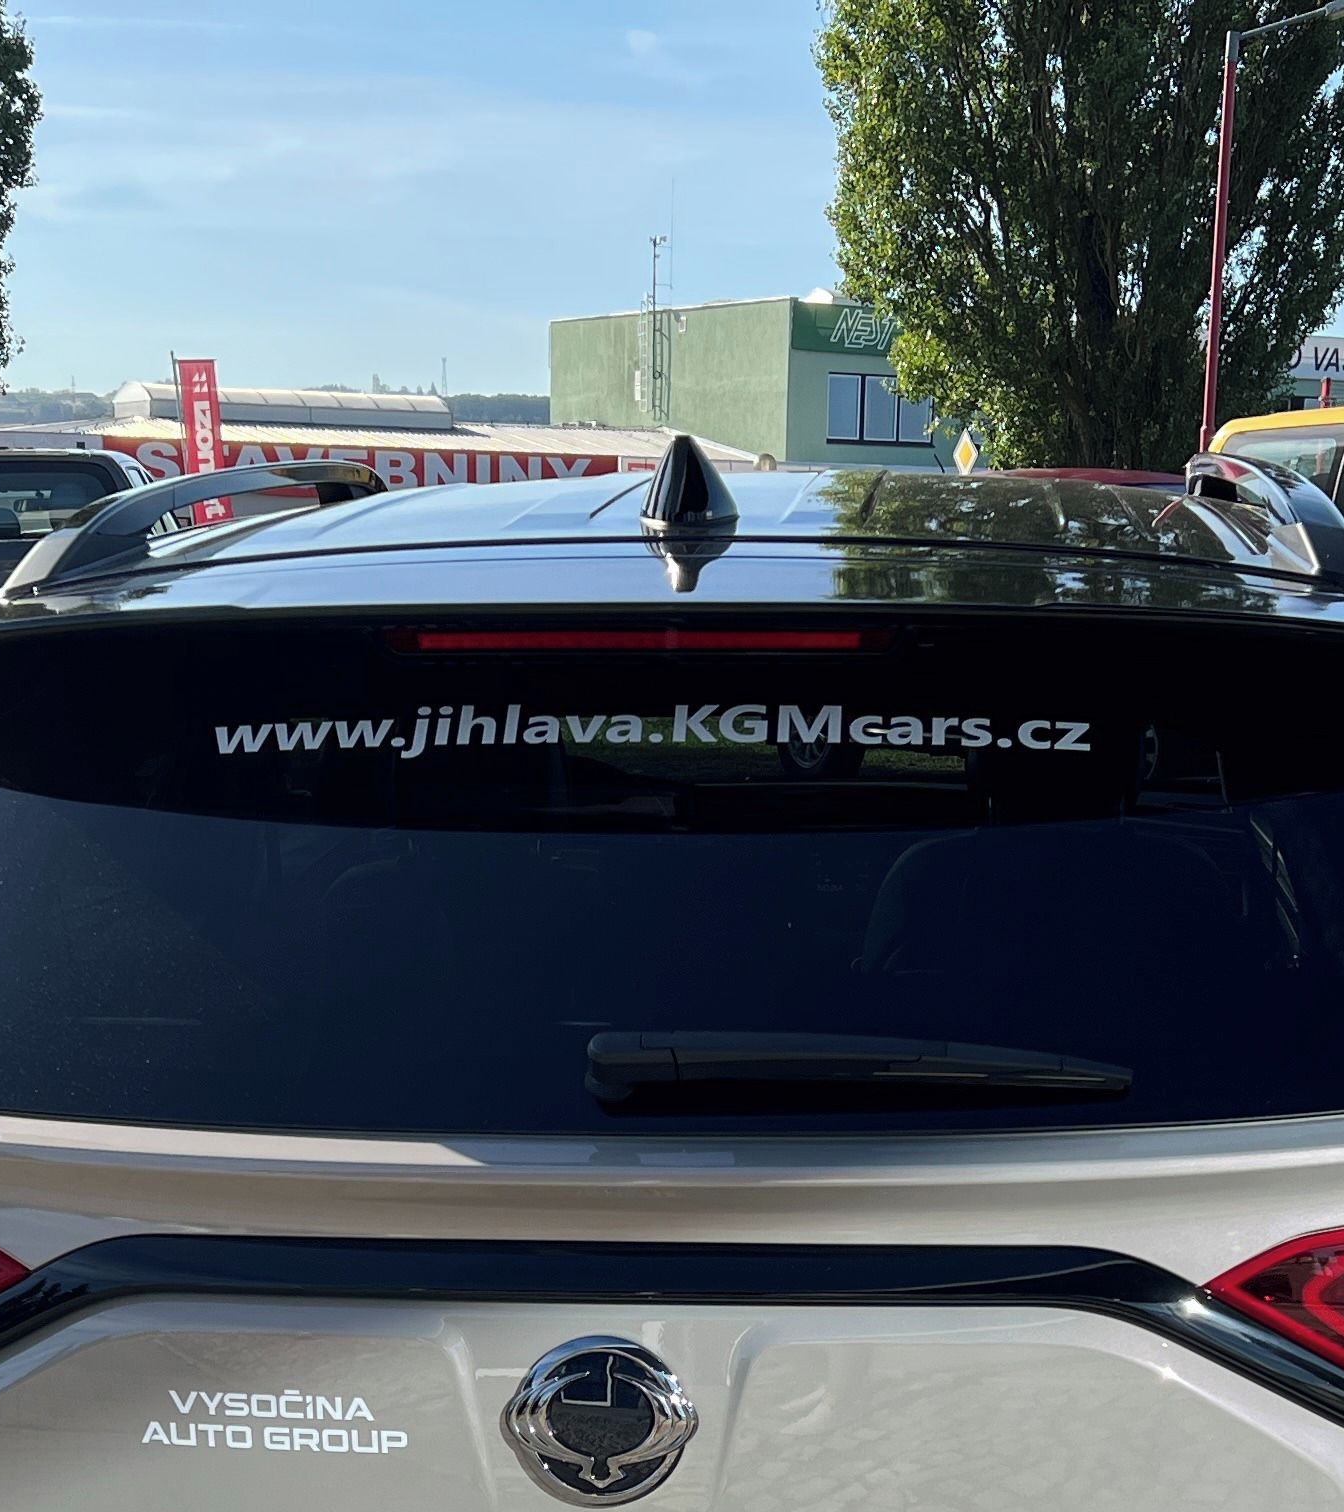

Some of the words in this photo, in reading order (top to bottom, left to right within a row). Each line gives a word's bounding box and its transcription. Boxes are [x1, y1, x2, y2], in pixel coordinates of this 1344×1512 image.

[137, 441, 592, 491] SABNINY
[194, 400, 227, 520] izomt
[214, 704, 1092, 759] www.jihlava.KGMcars.cz
[169, 1389, 375, 1421] VYSOČINA
[141, 1421, 253, 1449] AUTO
[263, 1426, 408, 1454] GROUP
